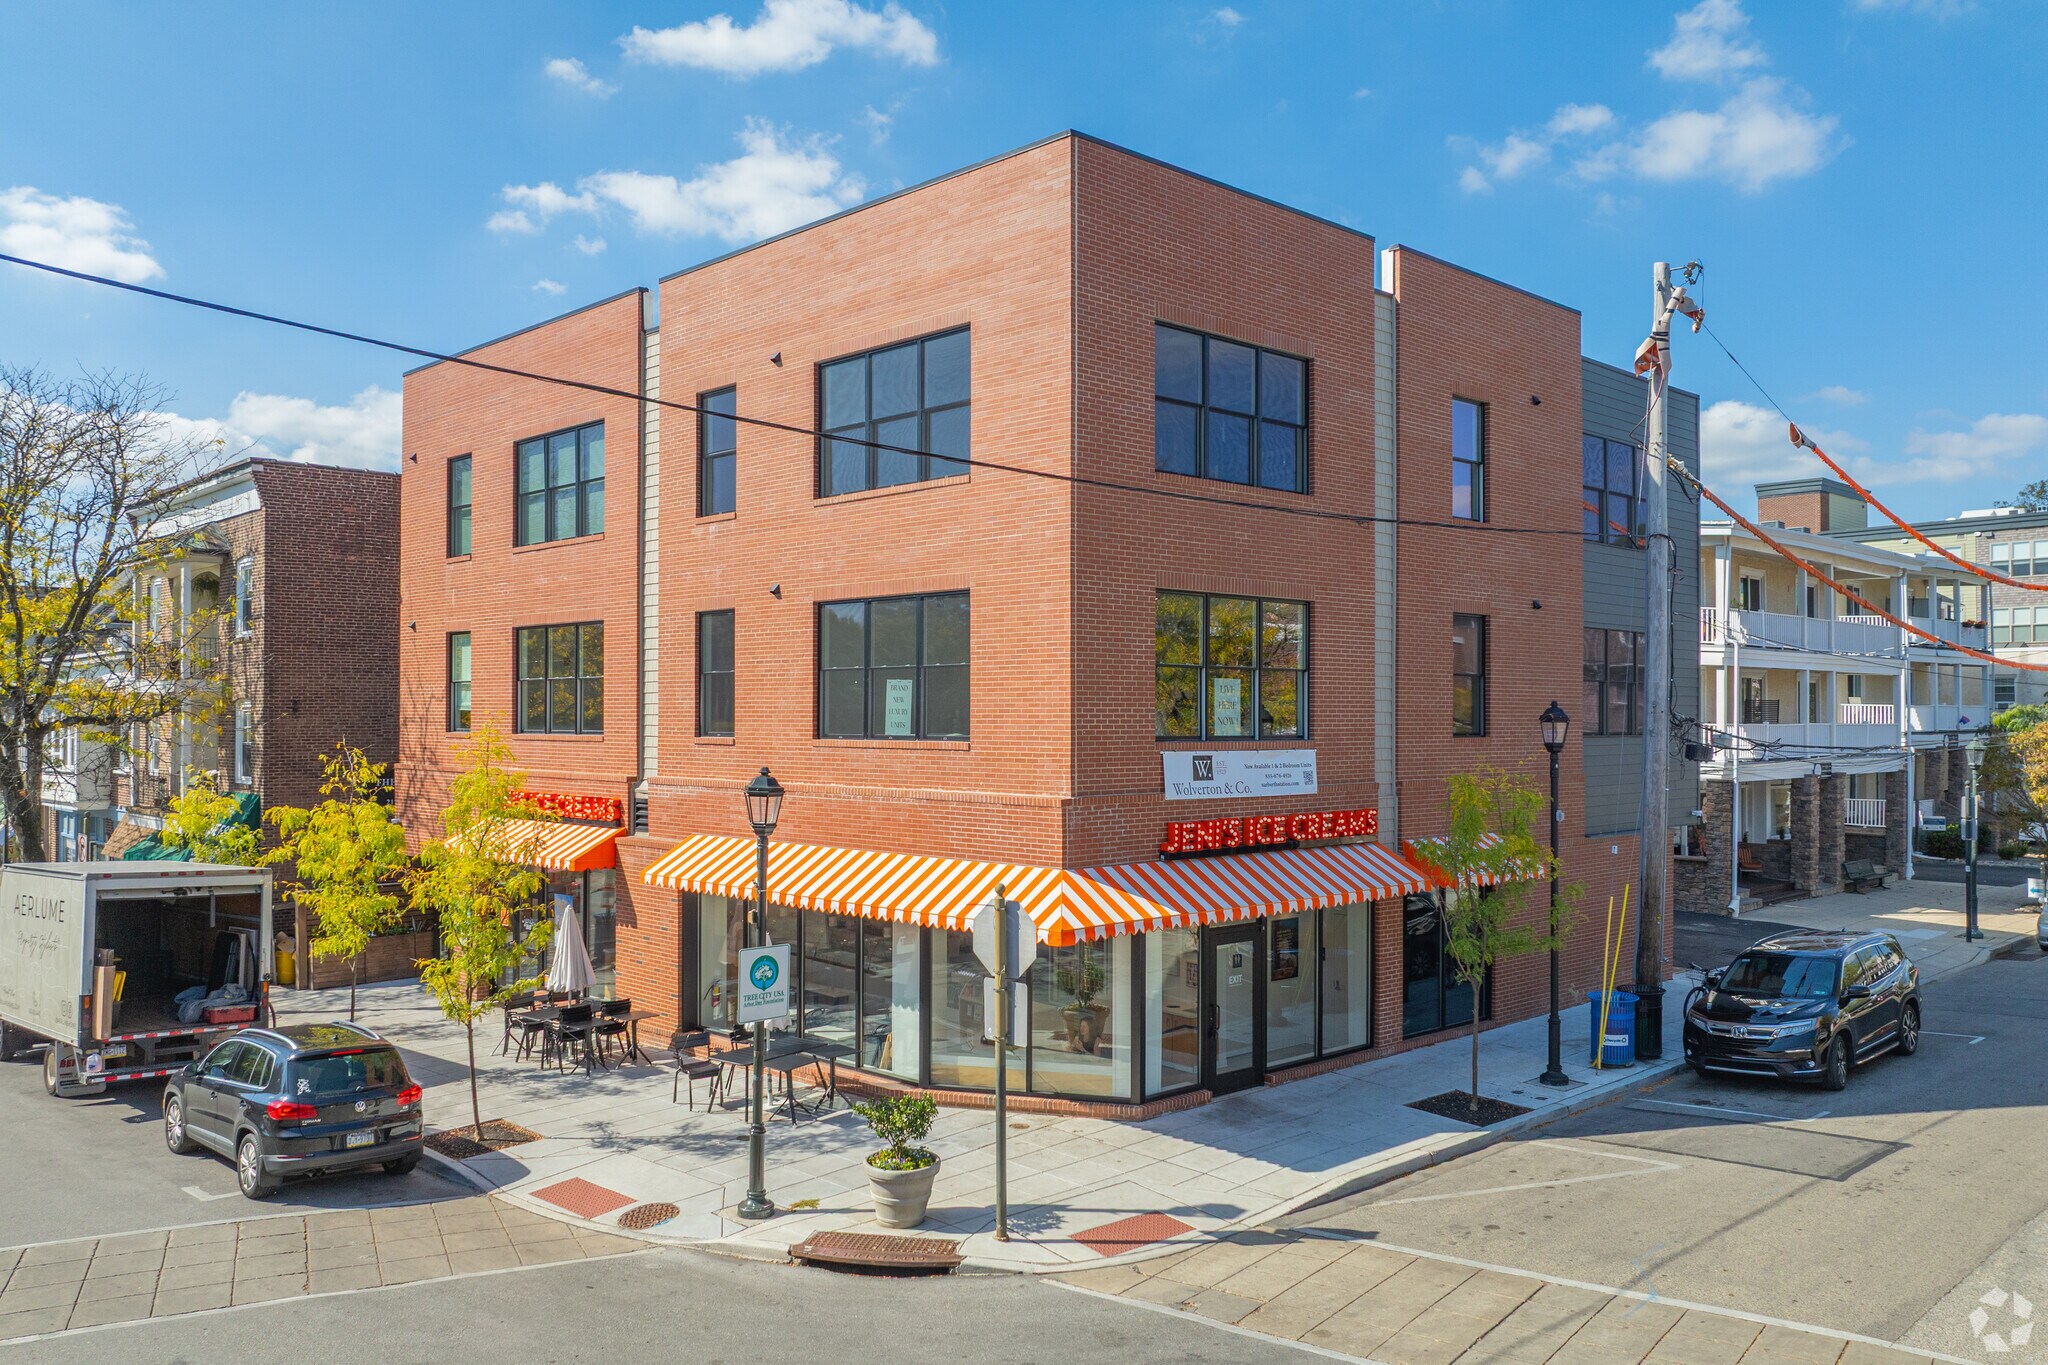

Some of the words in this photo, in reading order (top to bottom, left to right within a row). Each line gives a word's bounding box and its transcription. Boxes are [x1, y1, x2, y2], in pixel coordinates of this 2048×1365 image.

[1173, 782, 1222, 796] Wolverton
[1224, 783, 1233, 795] &
[1235, 781, 1252, 794] Co.
[1160, 817, 1241, 853] JENI'S
[1243, 815, 1287, 846] ICE
[1286, 808, 1379, 841] CREAMS
[14, 894, 65, 923] AERLUME
[1228, 975, 1242, 985] EXIT
